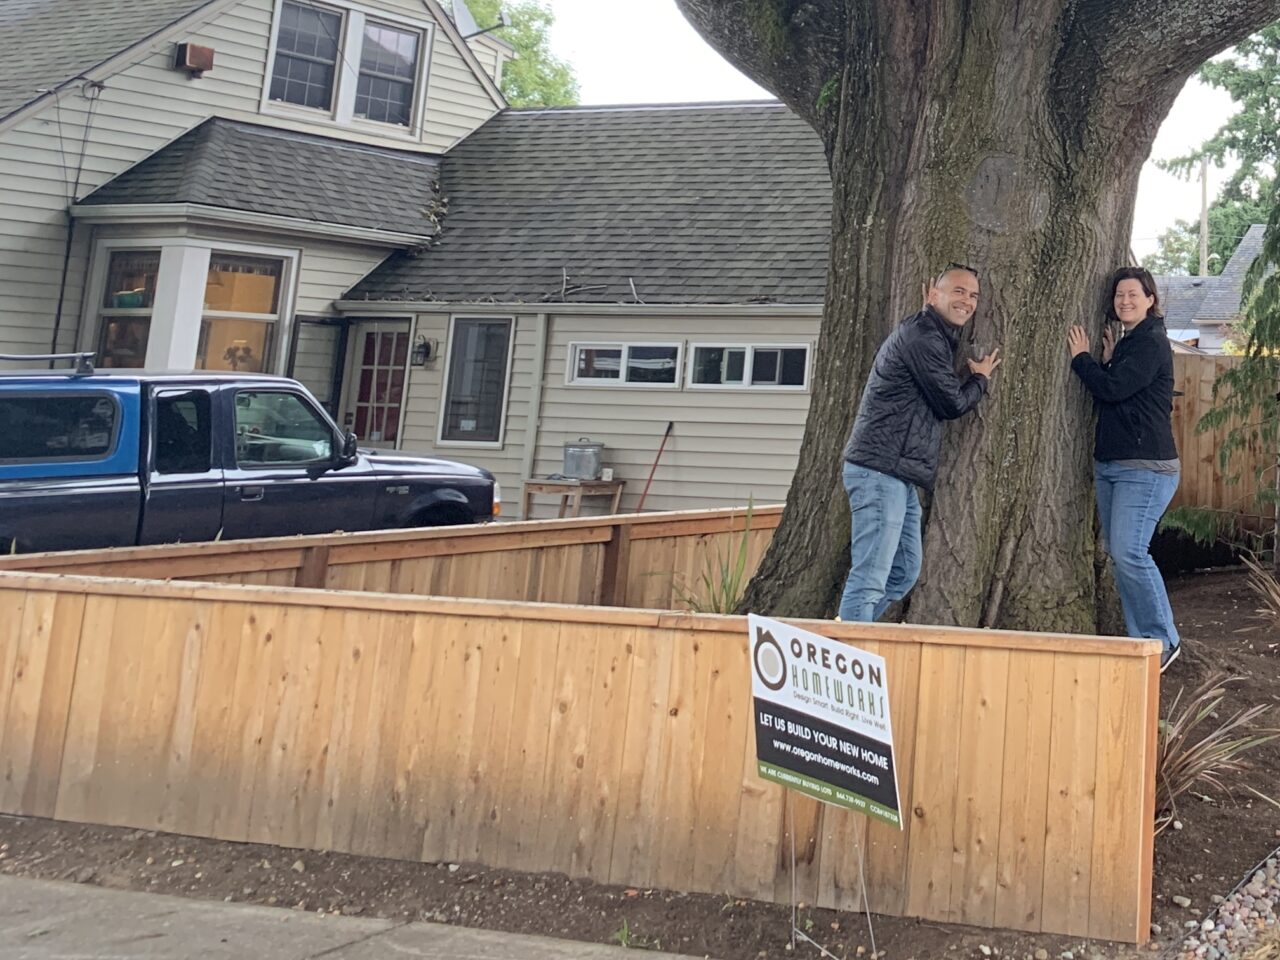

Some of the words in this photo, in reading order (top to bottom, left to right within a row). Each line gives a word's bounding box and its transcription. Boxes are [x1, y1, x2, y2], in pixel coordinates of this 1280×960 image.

[790, 637, 882, 688] OREGON
[791, 664, 884, 719] HOMEWORKS
[793, 691, 811, 704] Design
[830, 703, 845, 716] Build
[861, 715, 874, 726] Live
[759, 712, 773, 727] LET
[774, 717, 786, 732] US
[787, 722, 812, 740] BUILD
[812, 730, 838, 751] YOUR
[839, 739, 860, 758] NEW
[861, 748, 889, 770] HOME
[772, 739, 880, 786] www.oregonhomeworks.com
[760, 765, 768, 774] WE
[768, 768, 777, 777] ARE
[777, 771, 802, 785] CURRENTLY
[802, 779, 821, 792] BUYING
[821, 786, 833, 796] LOTS
